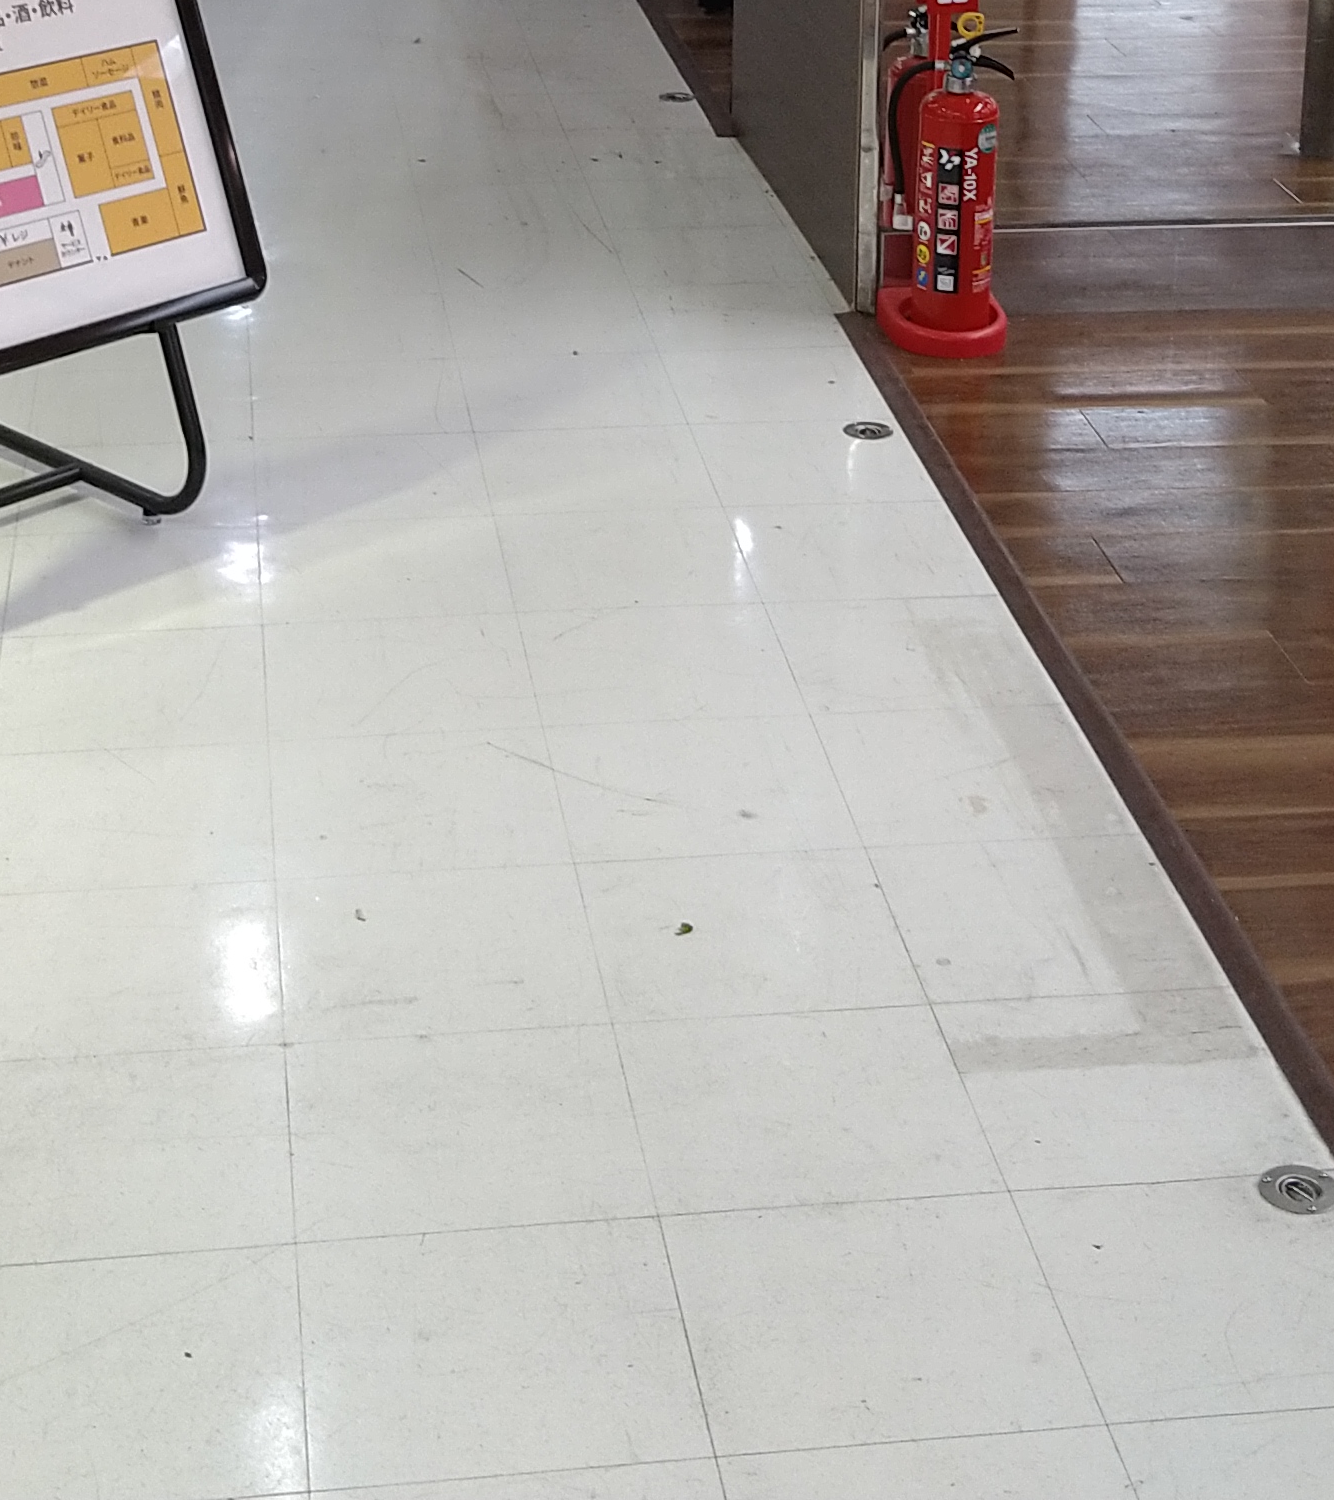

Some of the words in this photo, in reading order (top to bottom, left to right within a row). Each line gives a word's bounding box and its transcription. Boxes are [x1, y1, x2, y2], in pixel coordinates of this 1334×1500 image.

[92, 63, 129, 79] ソーセージ
[72, 99, 117, 118] デイリー食品
[962, 147, 978, 202] YA-10X
